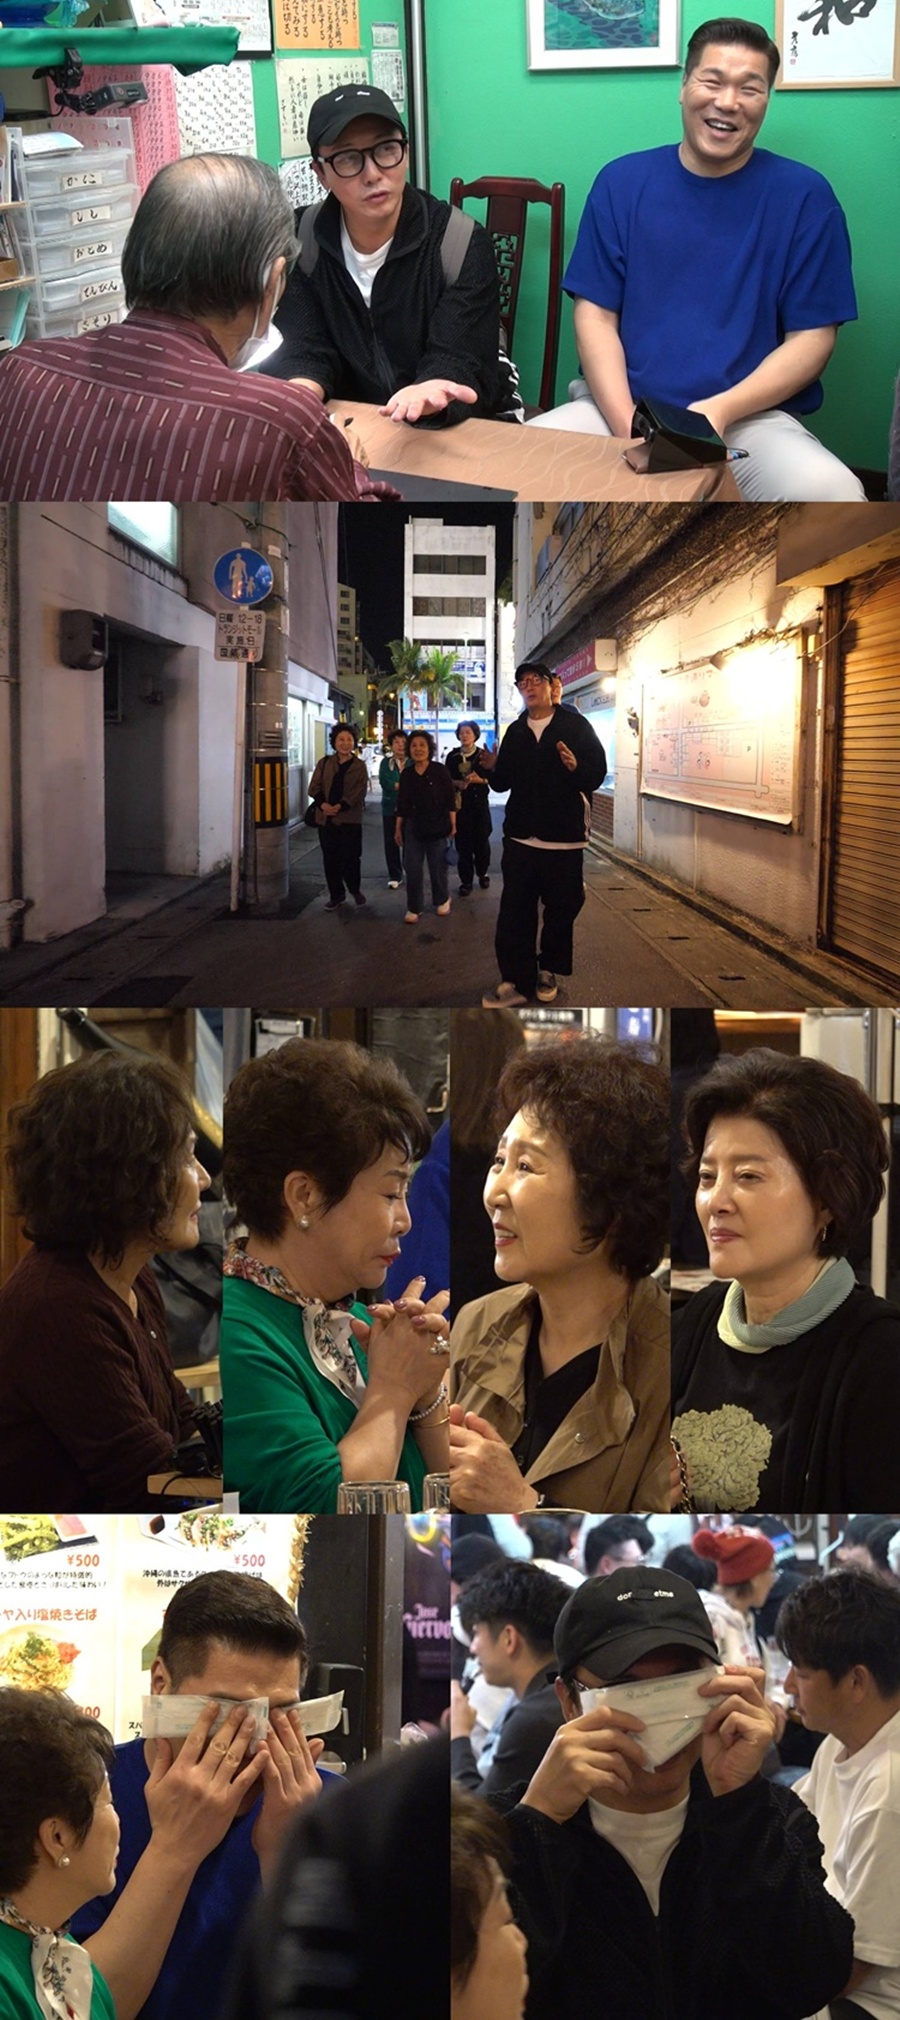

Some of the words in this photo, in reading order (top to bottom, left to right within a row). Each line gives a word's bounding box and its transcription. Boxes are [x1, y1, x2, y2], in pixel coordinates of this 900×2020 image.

[66, 174, 96, 186] かに
[76, 210, 98, 222] しし
[76, 244, 107, 259] おとめ
[84, 280, 117, 298] てんびん
[82, 314, 111, 330] さそり
[67, 1554, 100, 1567] ¥500
[234, 1554, 265, 1567] ¥500
[0, 1608, 97, 1621] ヤ入り塩焼きそば
